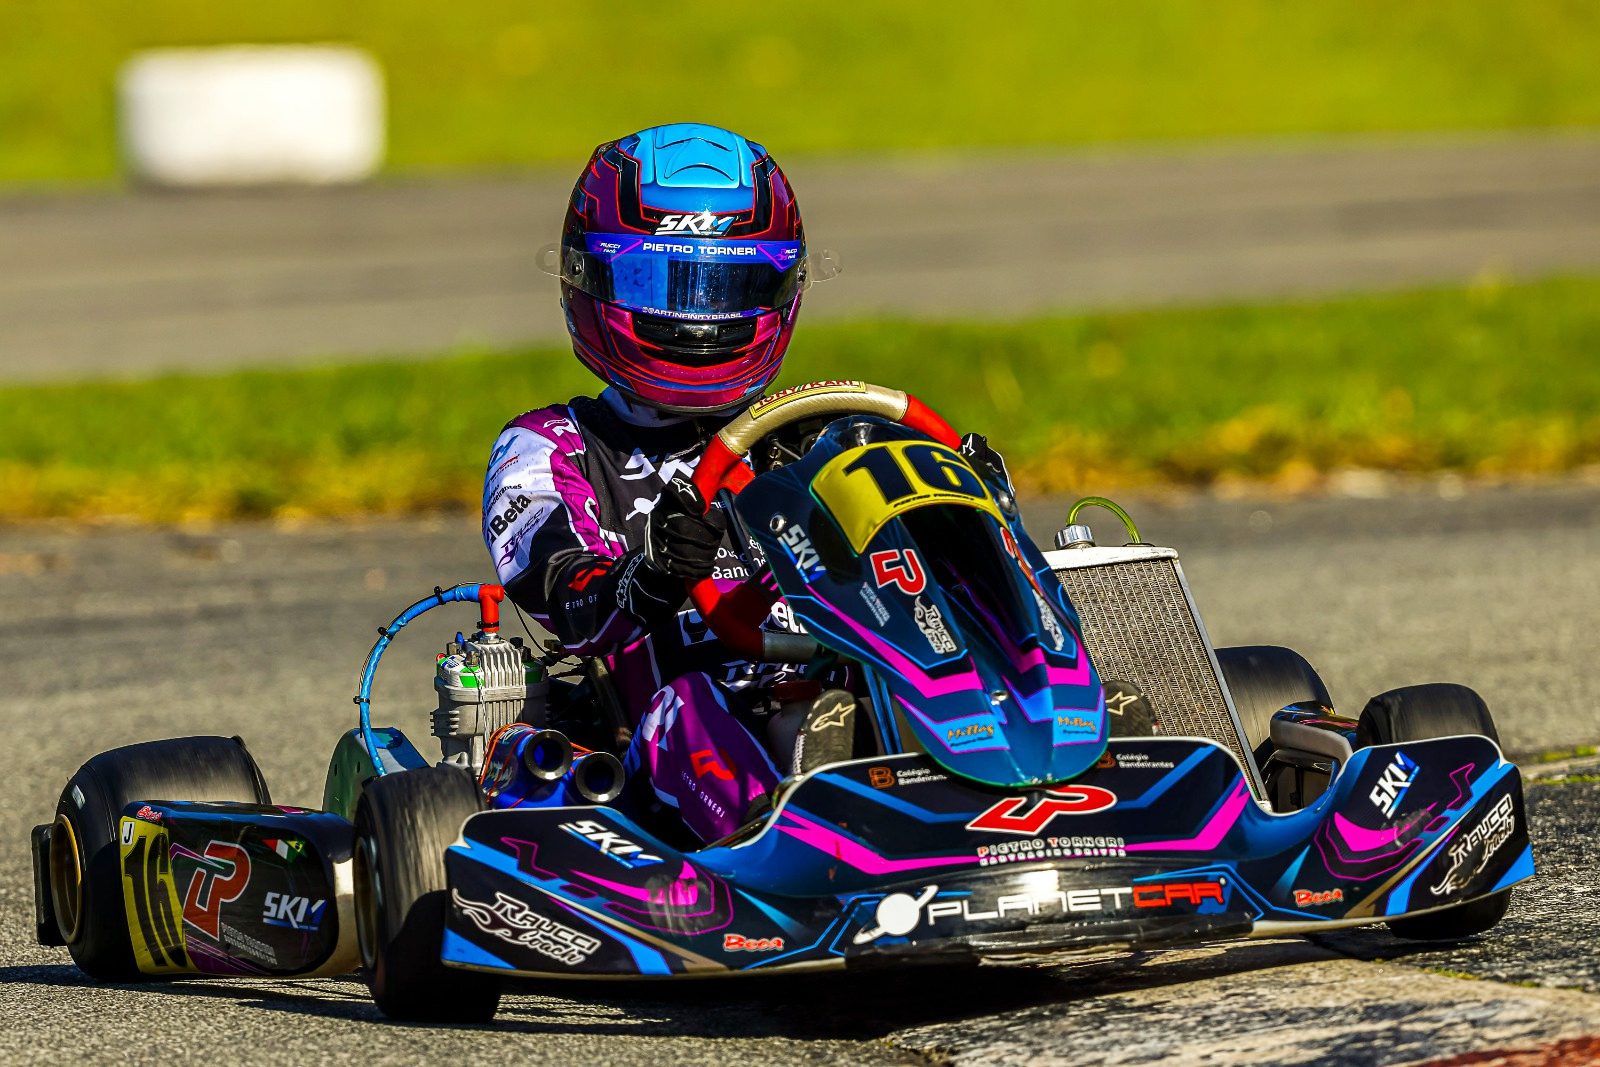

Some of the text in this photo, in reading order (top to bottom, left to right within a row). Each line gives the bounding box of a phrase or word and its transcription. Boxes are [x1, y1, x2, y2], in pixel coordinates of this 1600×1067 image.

[642, 243, 757, 256] PIETRO TORNERI
[841, 444, 988, 505] 16
[489, 494, 532, 538] Beta
[1118, 760, 1175, 770] Bandeirantes
[123, 823, 134, 844] J
[977, 836, 1126, 858] PIETRO TORNERI
[124, 832, 188, 968] 16
